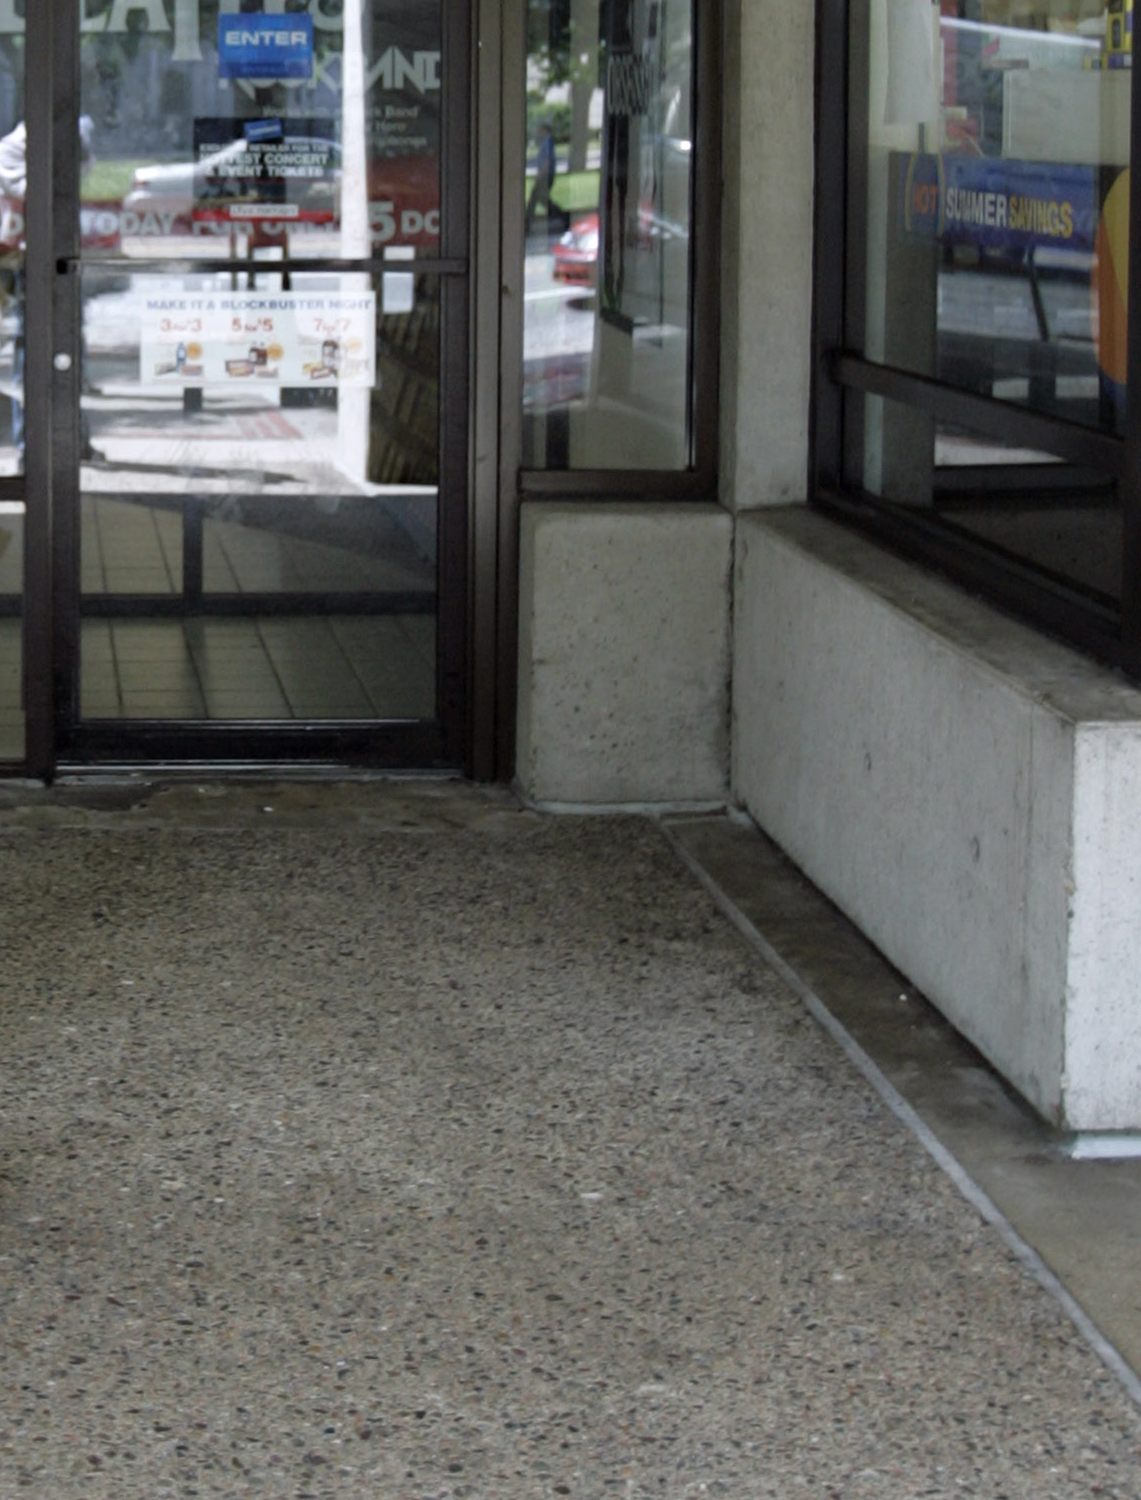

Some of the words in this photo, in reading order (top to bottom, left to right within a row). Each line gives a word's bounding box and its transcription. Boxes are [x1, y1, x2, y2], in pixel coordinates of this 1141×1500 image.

[225, 31, 307, 46] ENTER
[265, 153, 329, 165] CONCERT
[946, 187, 1007, 227] SUMMER
[1009, 195, 1074, 239] SAVINGS
[80, 211, 176, 236] TODAY
[147, 300, 186, 310] MAKE
[221, 300, 324, 310] BLOCKBUSTER
